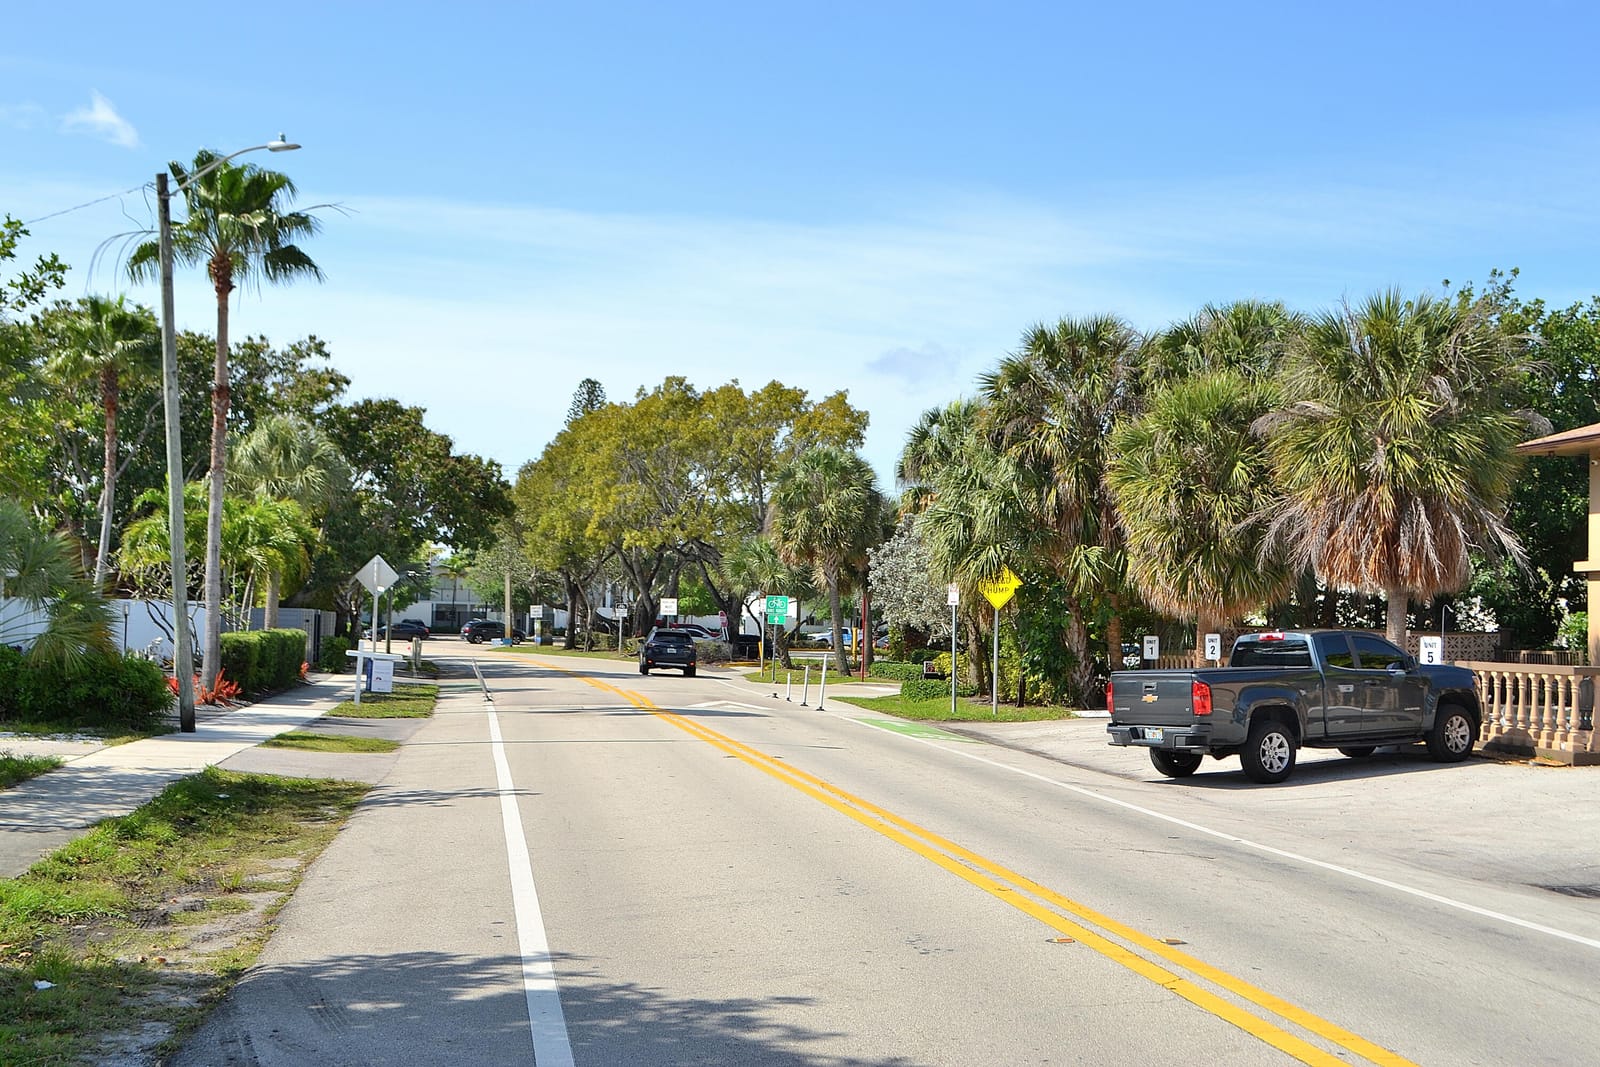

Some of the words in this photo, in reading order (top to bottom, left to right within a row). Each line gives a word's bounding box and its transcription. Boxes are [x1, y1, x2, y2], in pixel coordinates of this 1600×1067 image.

[1150, 647, 1153, 655] 1
[1210, 646, 1216, 655] 2
[1428, 652, 1434, 663] 5
